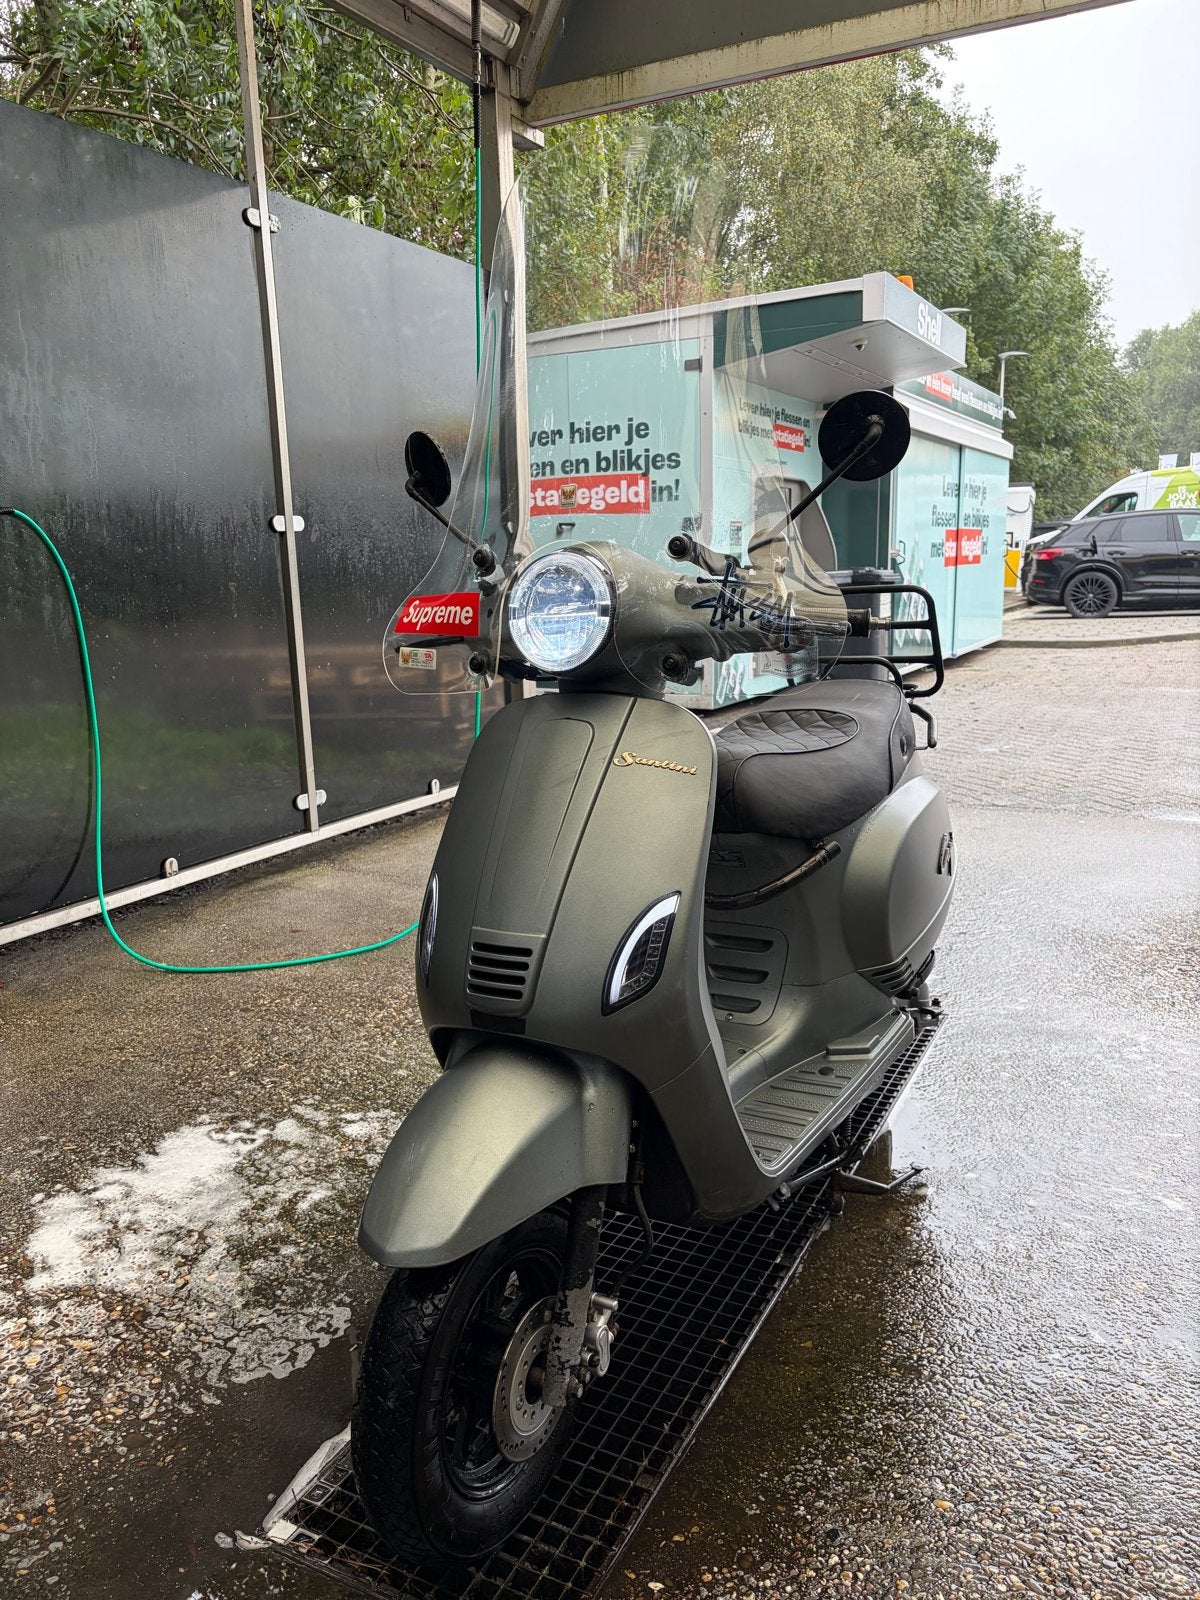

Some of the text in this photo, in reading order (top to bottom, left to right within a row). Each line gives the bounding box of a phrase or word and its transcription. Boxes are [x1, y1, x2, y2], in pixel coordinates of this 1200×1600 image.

[918, 303, 942, 346] Shell
[529, 417, 650, 447] ver hier je
[781, 408, 803, 427] flessen
[530, 448, 681, 478] en en blikjes
[529, 478, 680, 511] staegeld in!
[403, 600, 473, 631] Supreme
[613, 751, 698, 776] Santini
